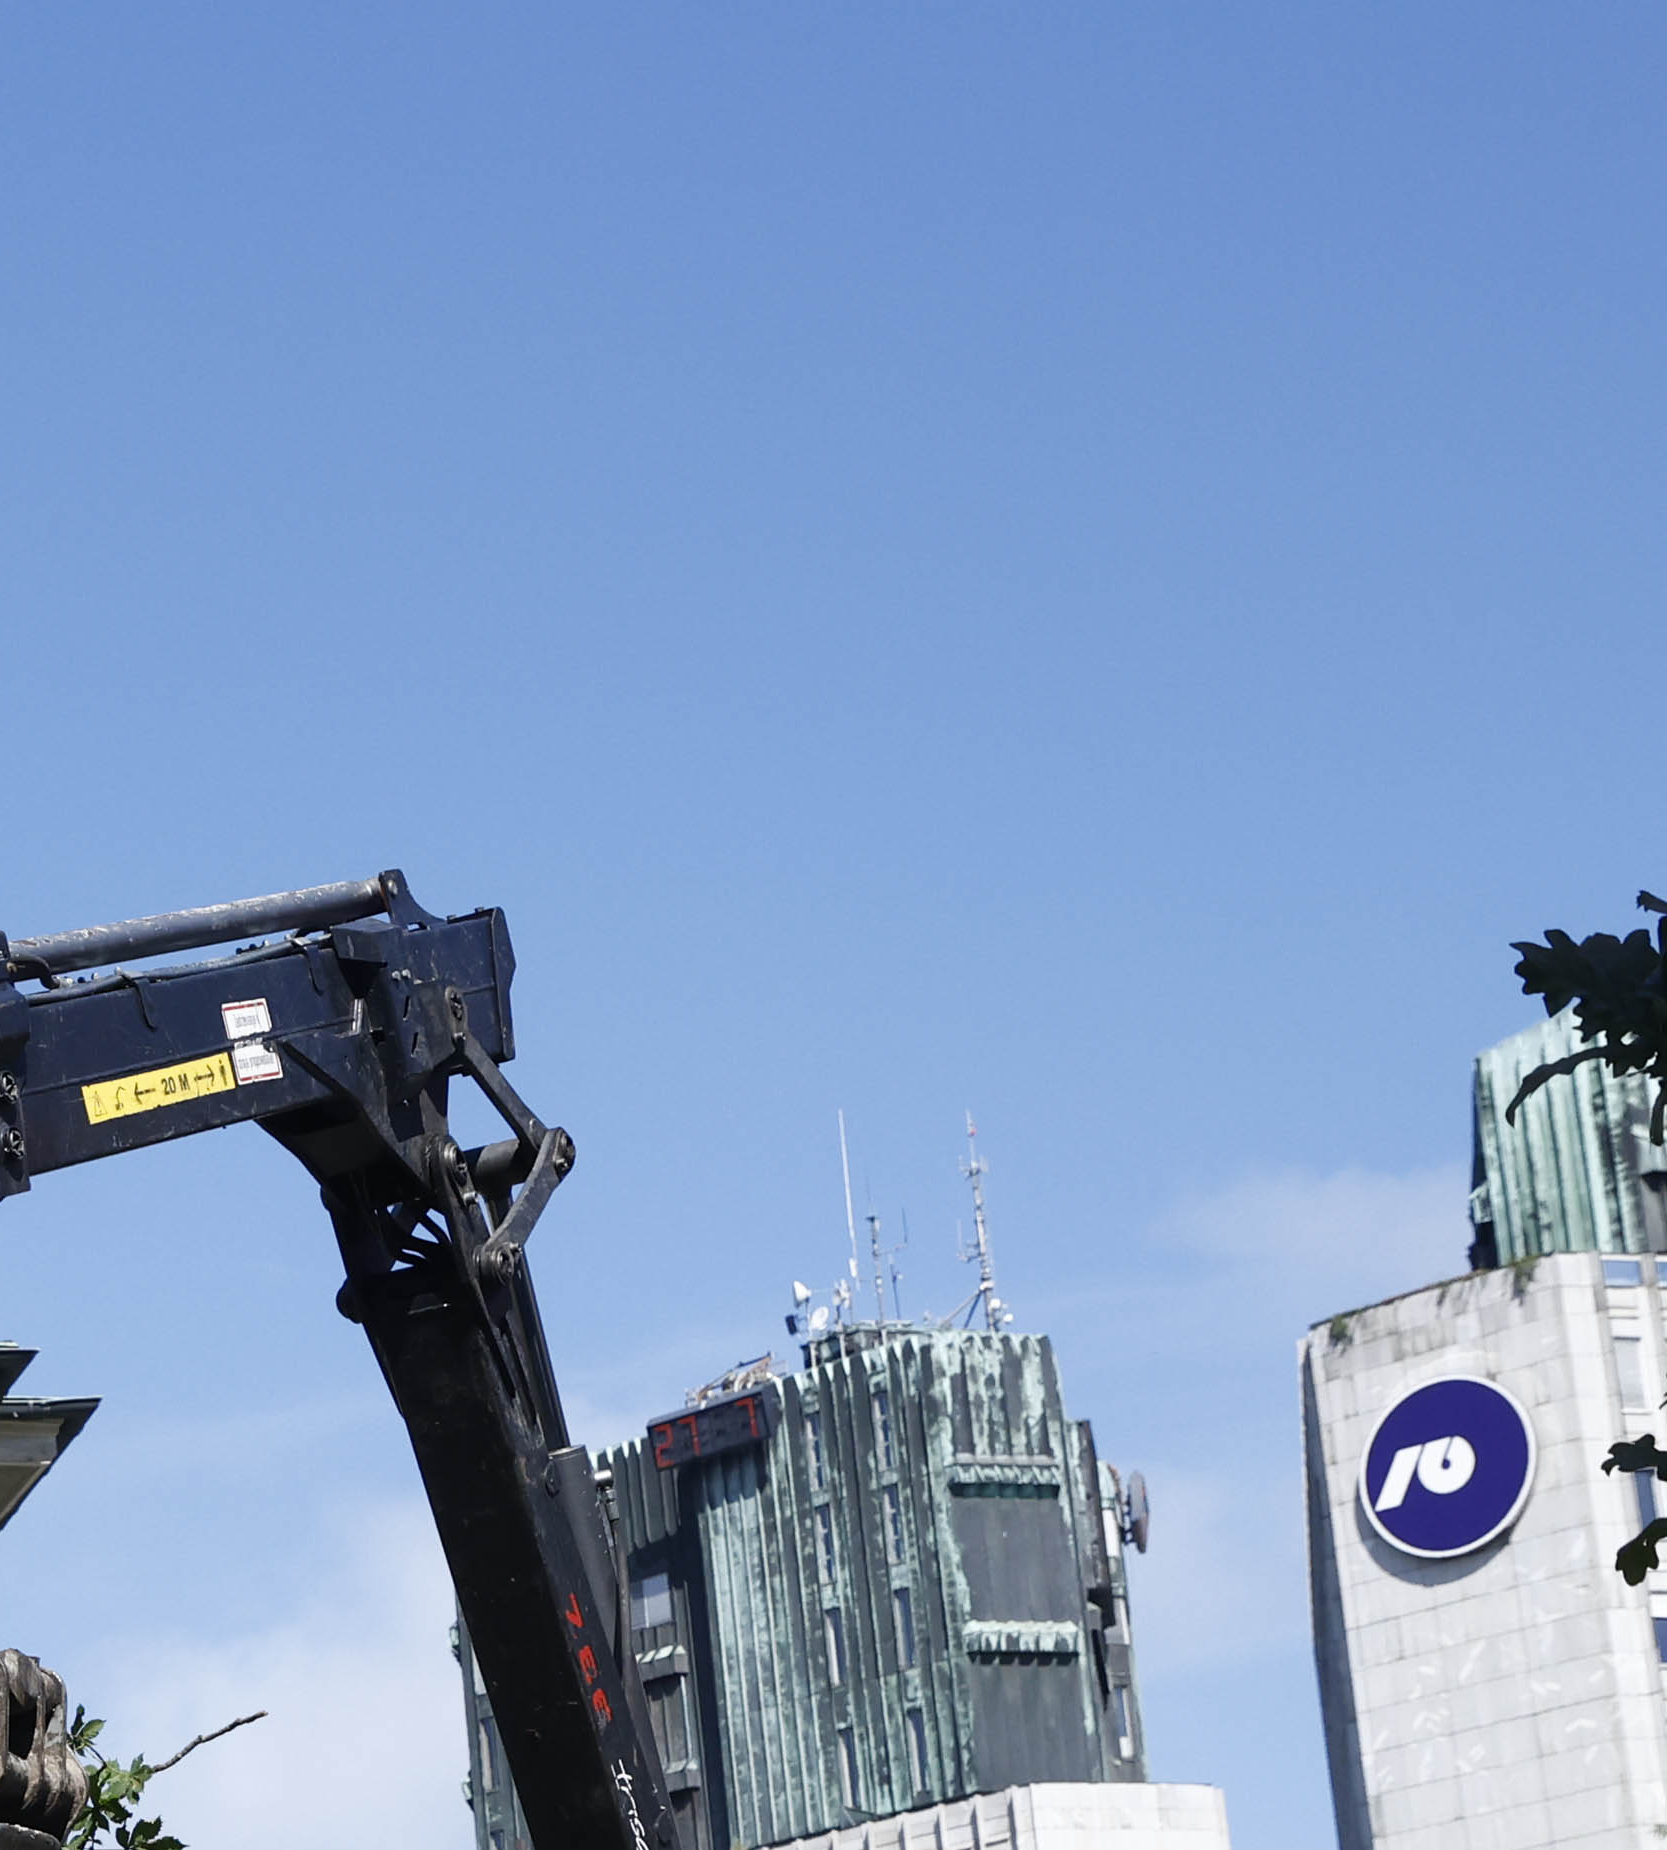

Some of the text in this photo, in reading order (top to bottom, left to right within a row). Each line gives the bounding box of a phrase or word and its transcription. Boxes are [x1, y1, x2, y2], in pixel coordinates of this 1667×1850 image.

[161, 1073, 191, 1096] 20 M
[653, 1396, 761, 1469] 27 7
